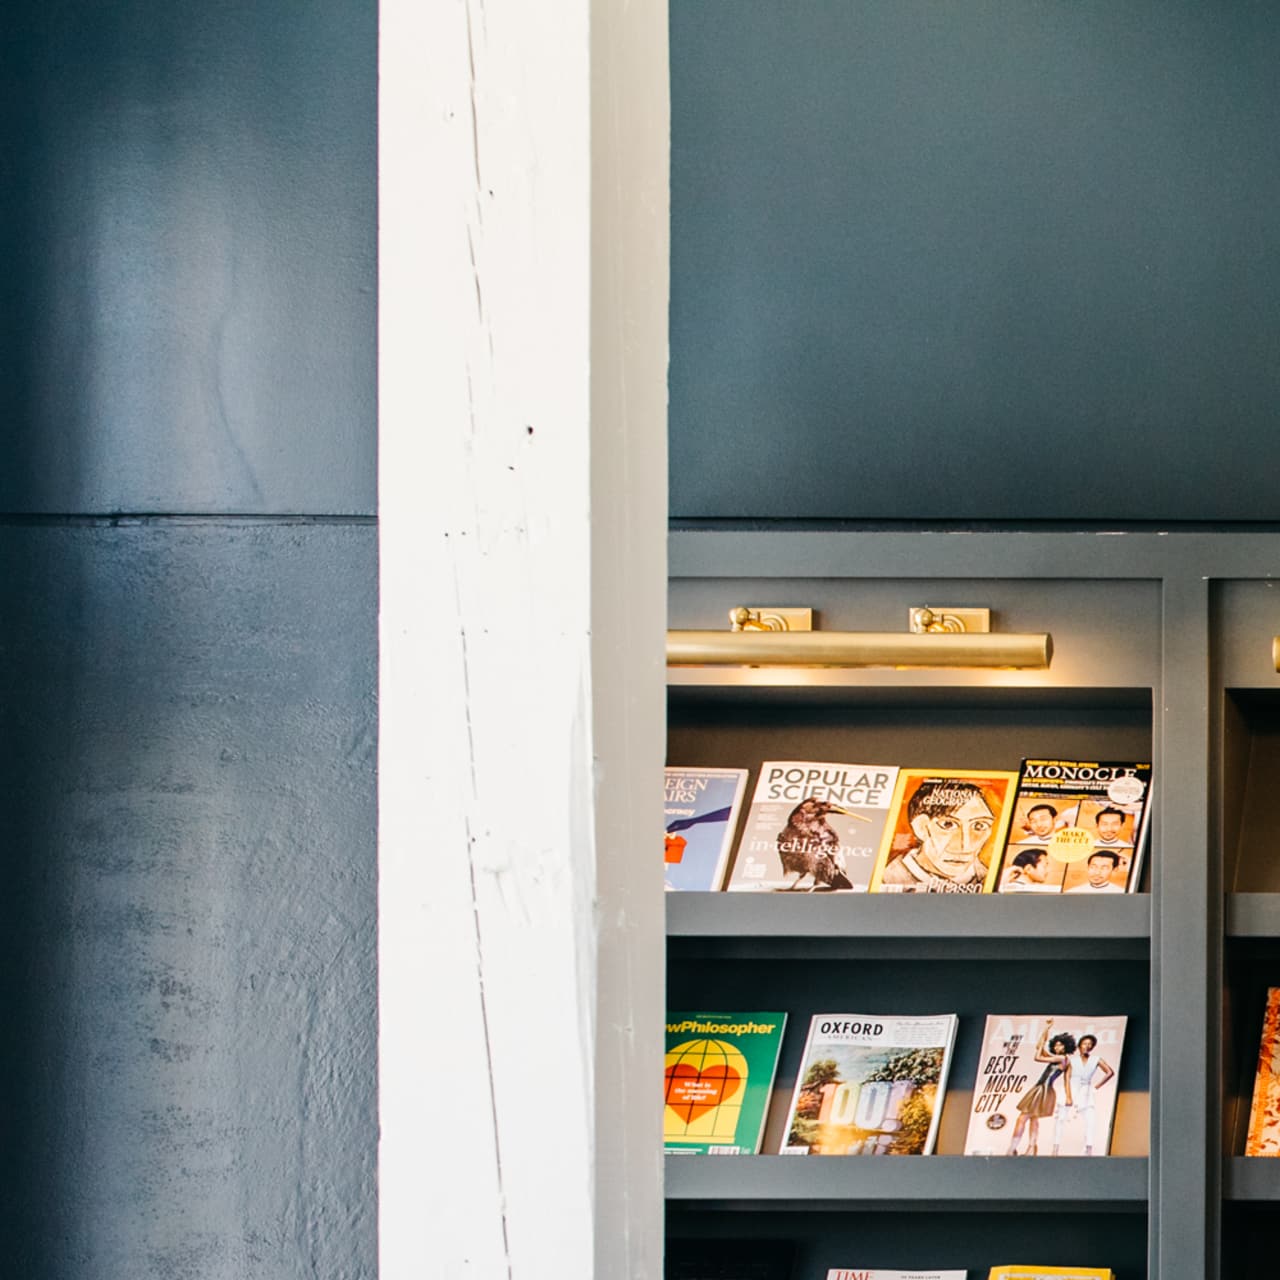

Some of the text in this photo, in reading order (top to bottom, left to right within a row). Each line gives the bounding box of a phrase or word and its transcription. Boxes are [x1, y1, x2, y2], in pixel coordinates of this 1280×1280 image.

[768, 768, 889, 789] POPULAR
[1023, 766, 1137, 781] MONOCLE
[768, 784, 881, 806] SCIENCE
[929, 880, 983, 893] Picasso
[665, 1021, 776, 1036] wPhilosopher
[821, 1022, 883, 1036] OXFORD
[984, 1056, 1019, 1075] BEST
[983, 1075, 1028, 1094] MUSIC
[974, 1094, 1006, 1113] CITY
